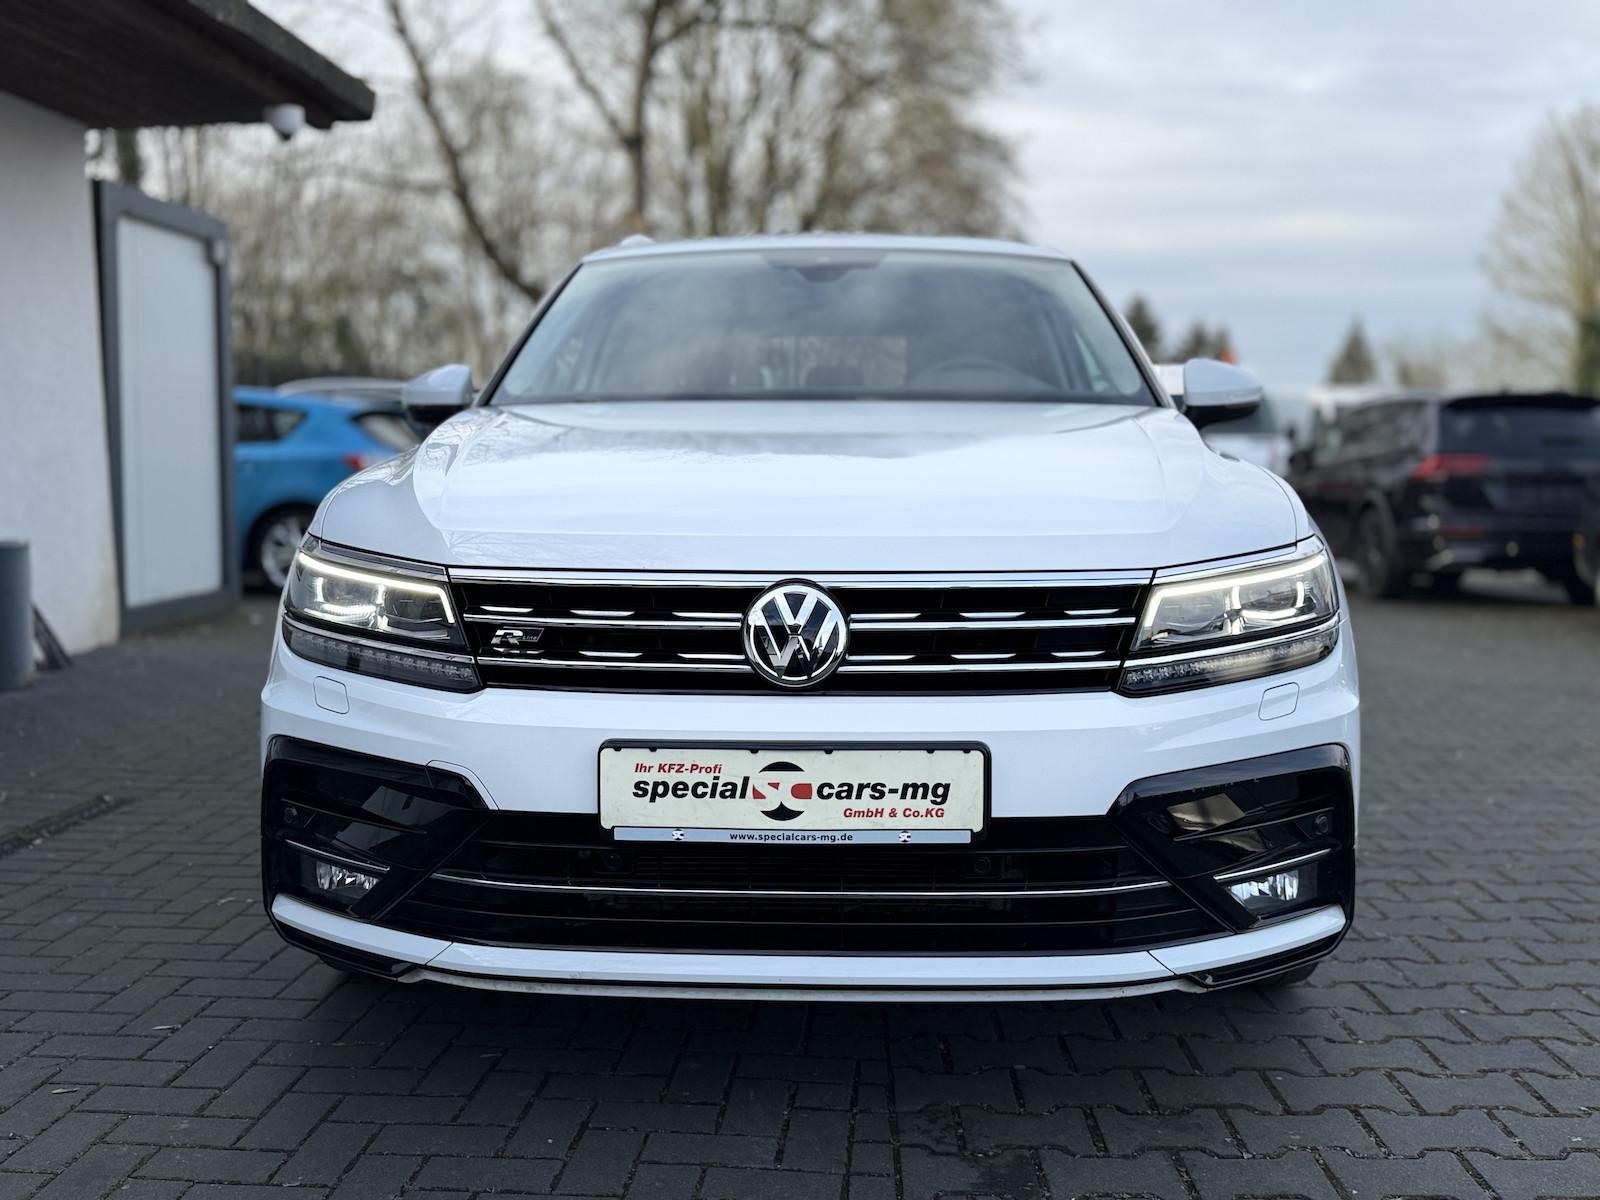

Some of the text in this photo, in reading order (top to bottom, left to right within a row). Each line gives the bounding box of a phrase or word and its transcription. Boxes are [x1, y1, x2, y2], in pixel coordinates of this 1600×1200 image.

[491, 629, 524, 645] R
[747, 585, 847, 683] VW
[634, 763, 723, 774] Ihr KFZ-Profi
[632, 776, 750, 803] special
[816, 782, 951, 806] cars-mg
[843, 808, 945, 818] GmbH & Co.KG
[729, 833, 853, 843] www.specialcars-mg.de
